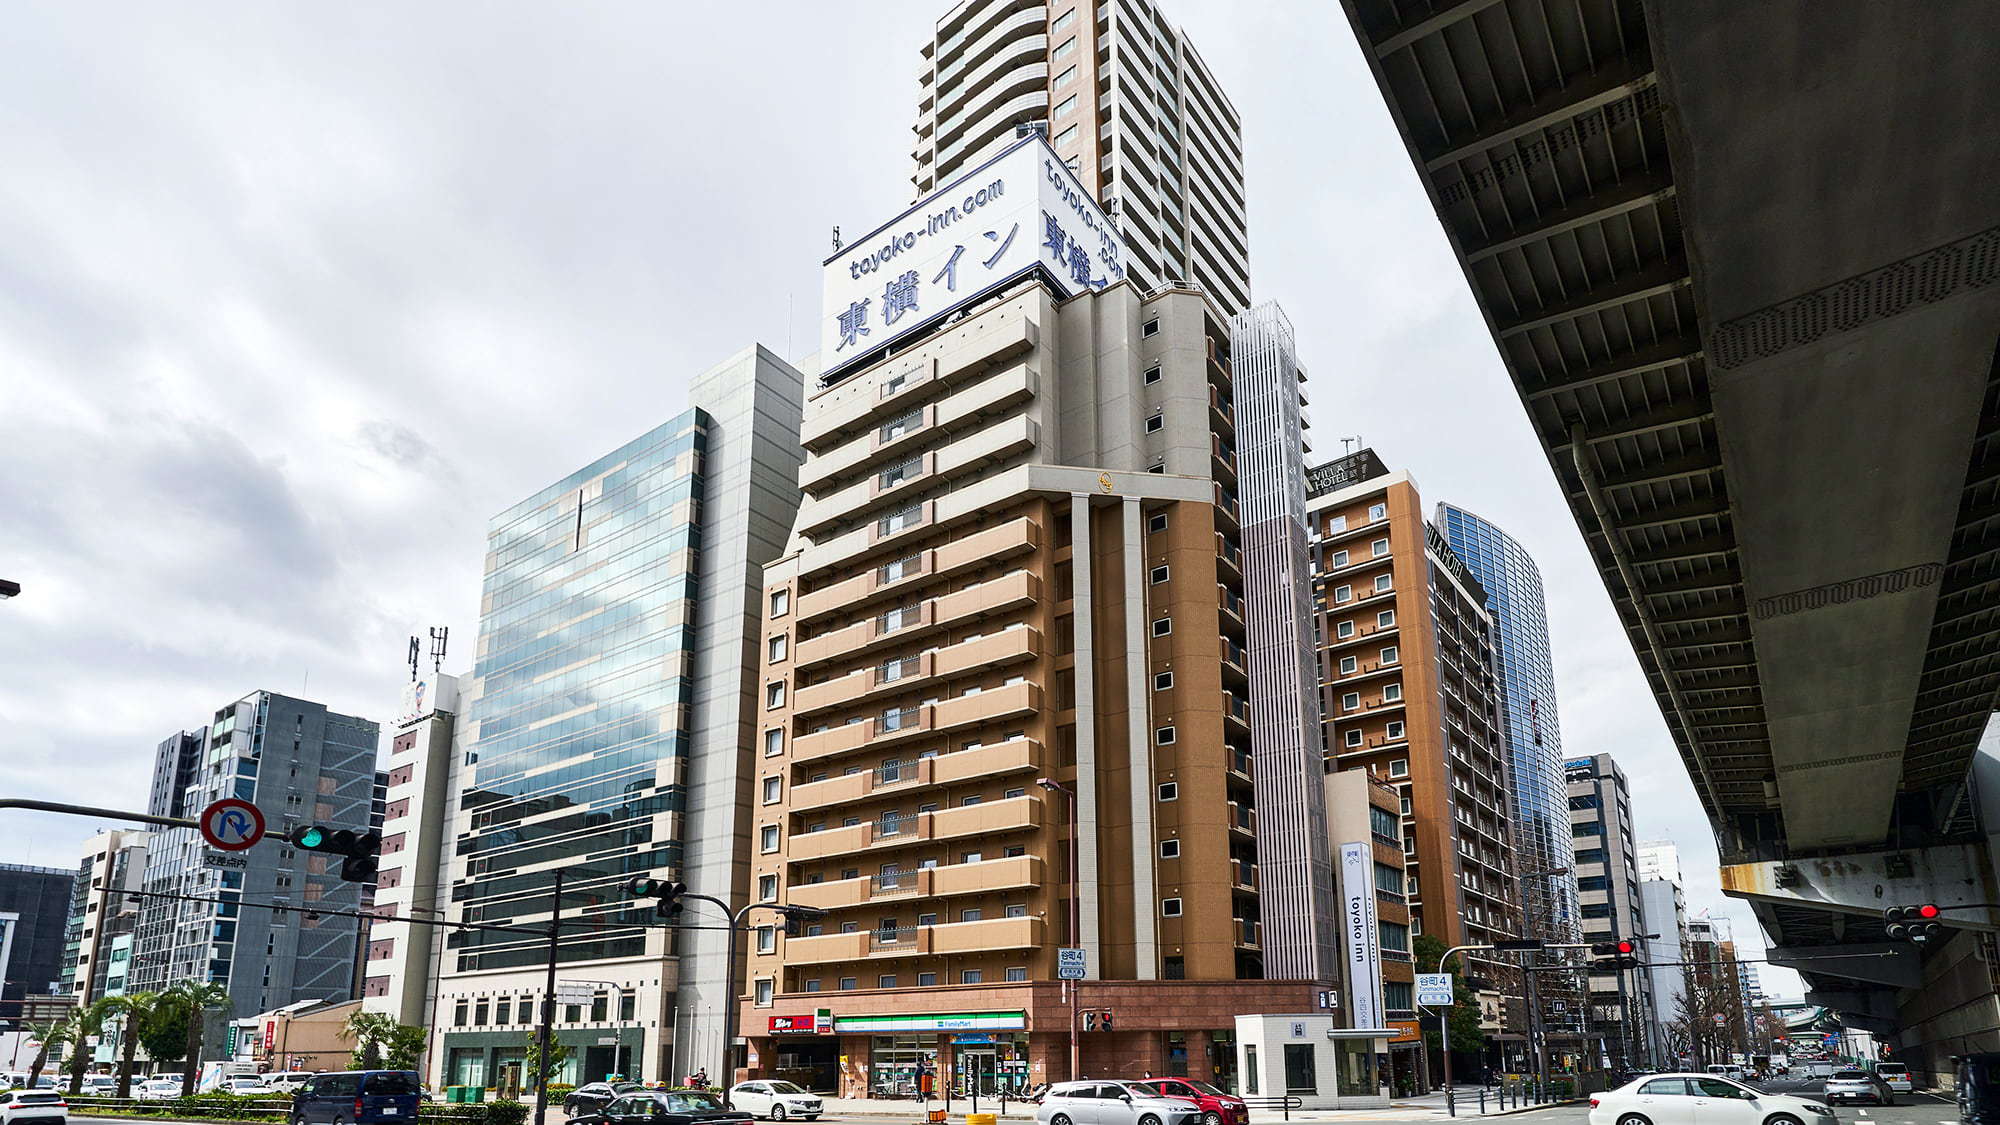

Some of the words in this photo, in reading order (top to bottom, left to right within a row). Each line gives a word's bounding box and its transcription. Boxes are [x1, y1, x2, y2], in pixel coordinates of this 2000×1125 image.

[849, 178, 1005, 281] toyoko-inn.com
[835, 221, 1020, 353] 東横イン
[1313, 464, 1345, 481] VILLA
[1314, 471, 1348, 490] HOTEL
[1441, 545, 1464, 582] HOTEL
[206, 854, 248, 869] 交差点内
[1351, 896, 1363, 939] toyoko
[1355, 942, 1365, 962] inn
[945, 1020, 971, 1028] FamilyMart
